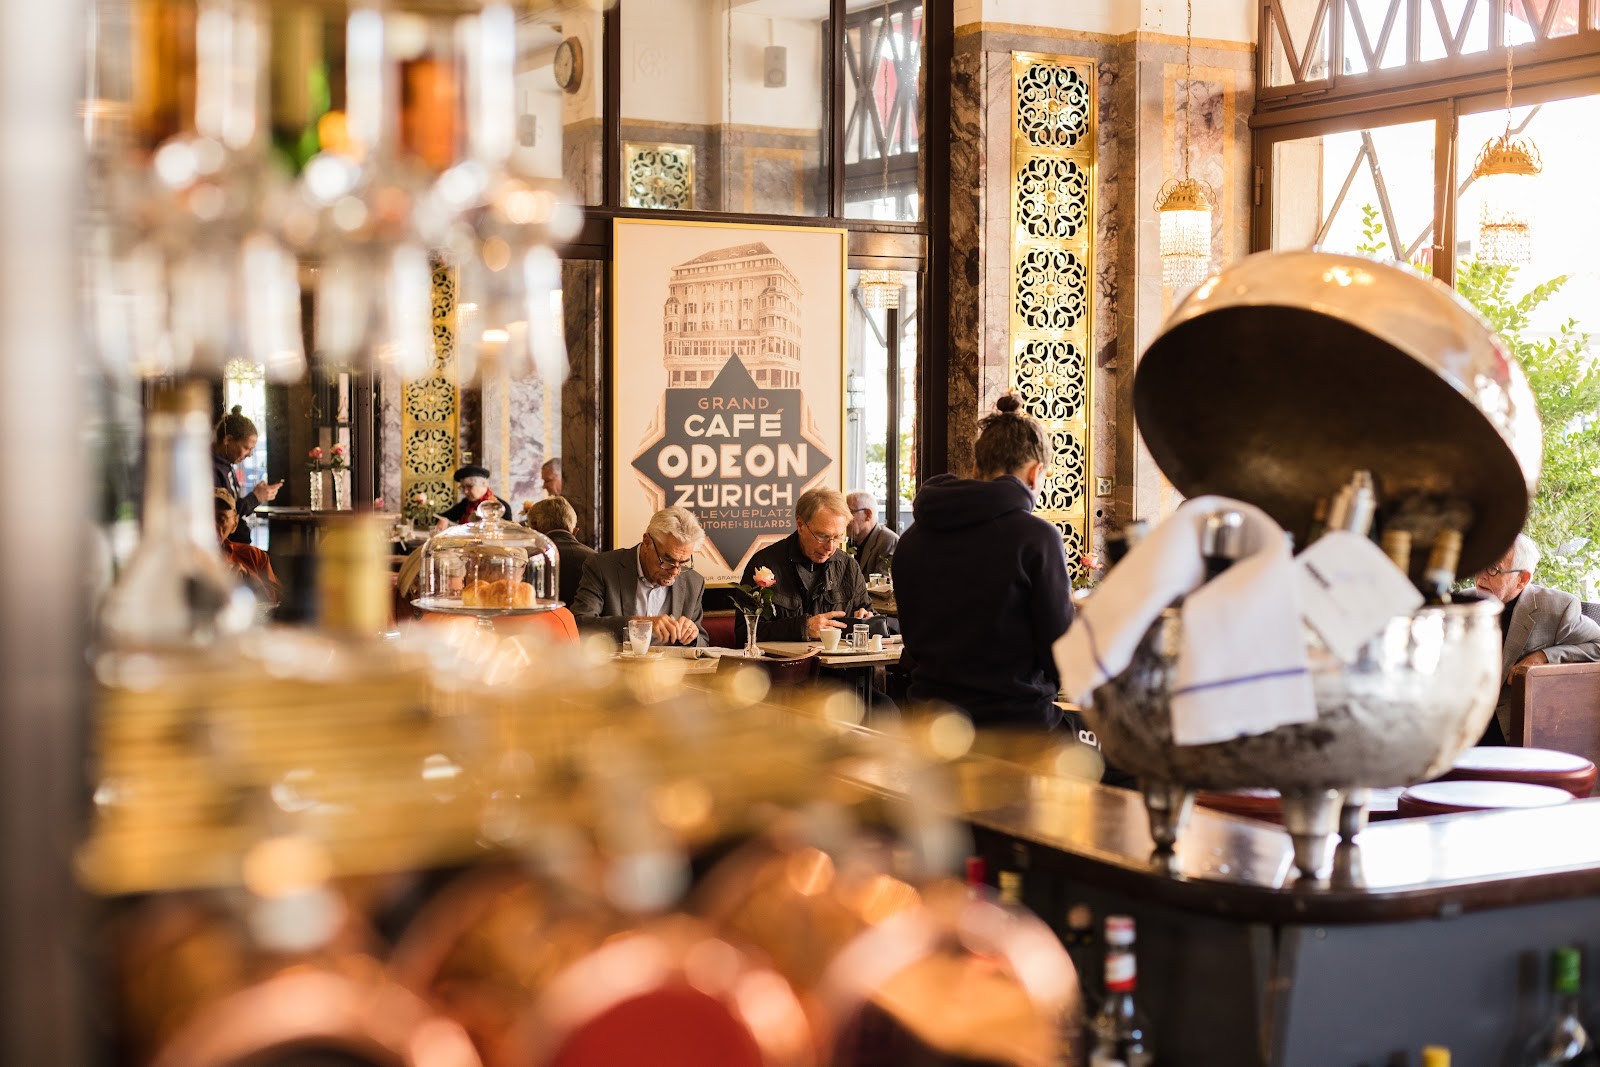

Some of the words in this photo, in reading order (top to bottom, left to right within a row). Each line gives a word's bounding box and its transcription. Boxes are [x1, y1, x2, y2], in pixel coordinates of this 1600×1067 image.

[698, 397, 769, 410] GRAND
[684, 408, 784, 438] CAFÉ
[657, 443, 808, 479] ODEON
[674, 483, 793, 508] ZÜRICH
